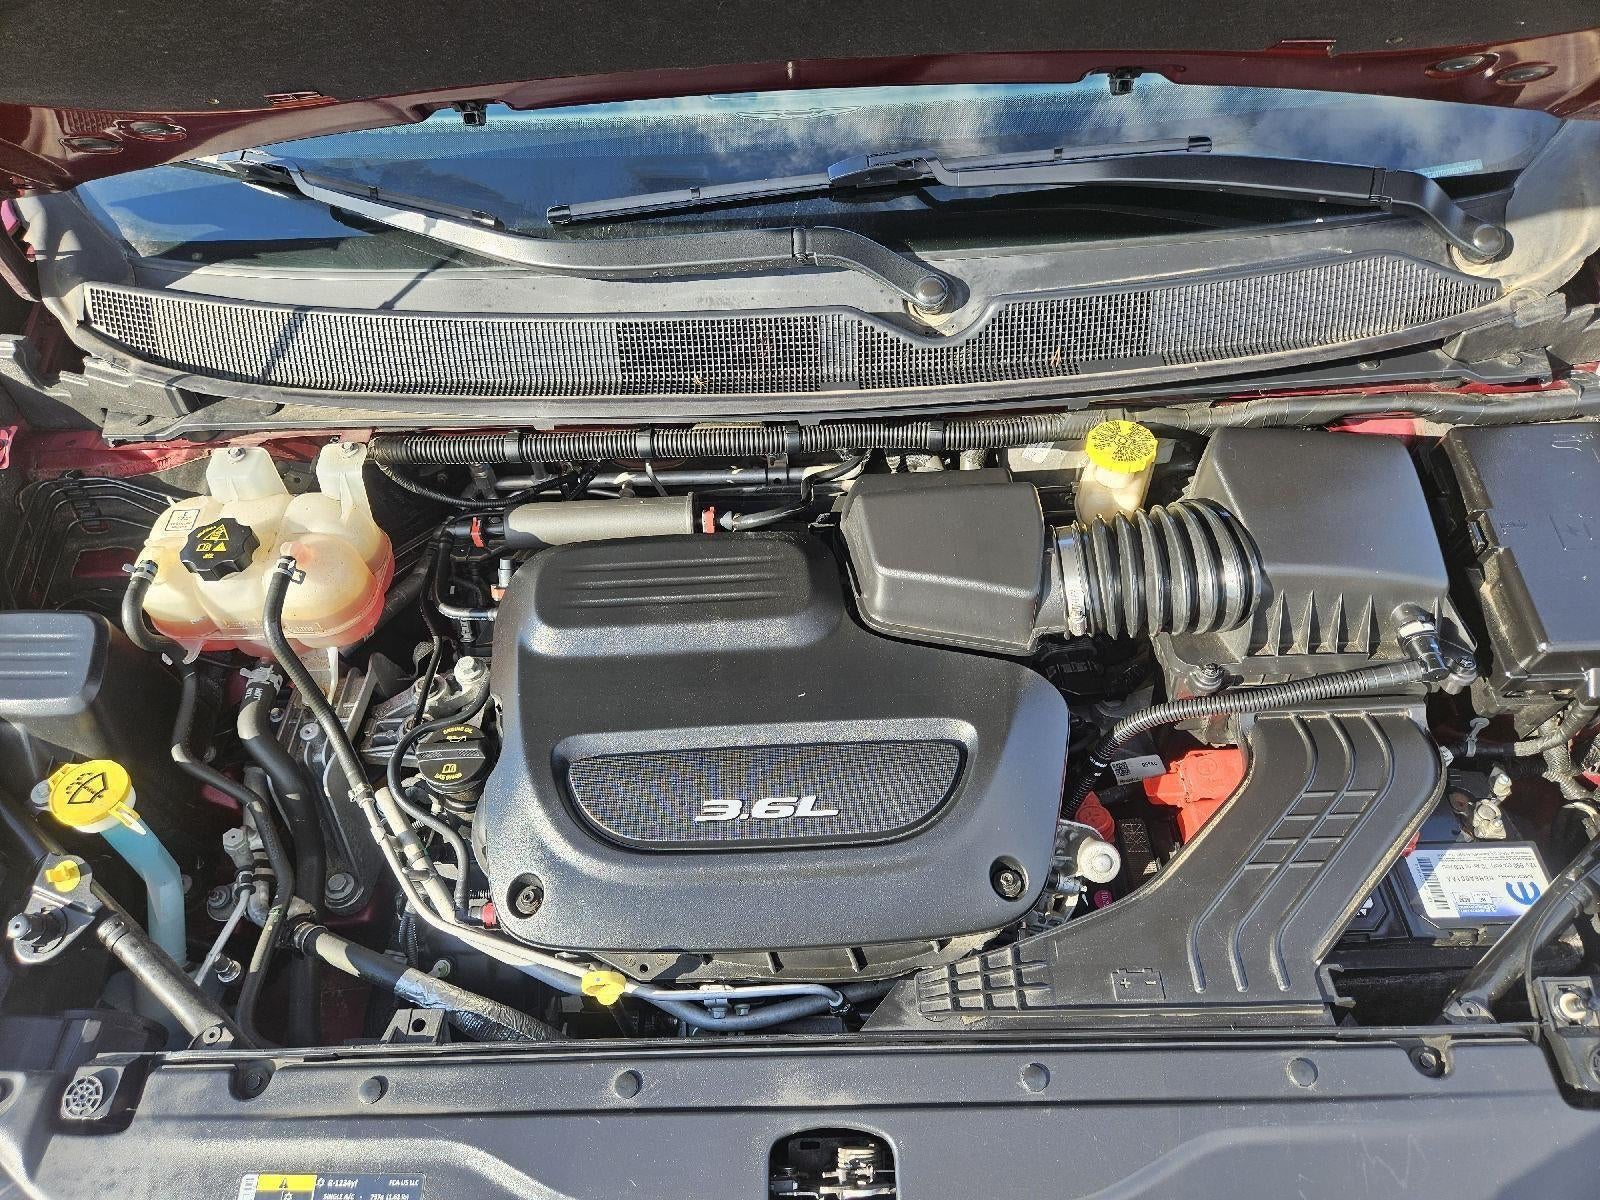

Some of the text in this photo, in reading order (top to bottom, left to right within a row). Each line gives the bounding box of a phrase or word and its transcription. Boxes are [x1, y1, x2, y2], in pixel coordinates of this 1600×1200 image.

[694, 795, 842, 821] 3.6L
[327, 1178, 359, 1188] R-1234yf
[409, 1178, 419, 1186] LLC
